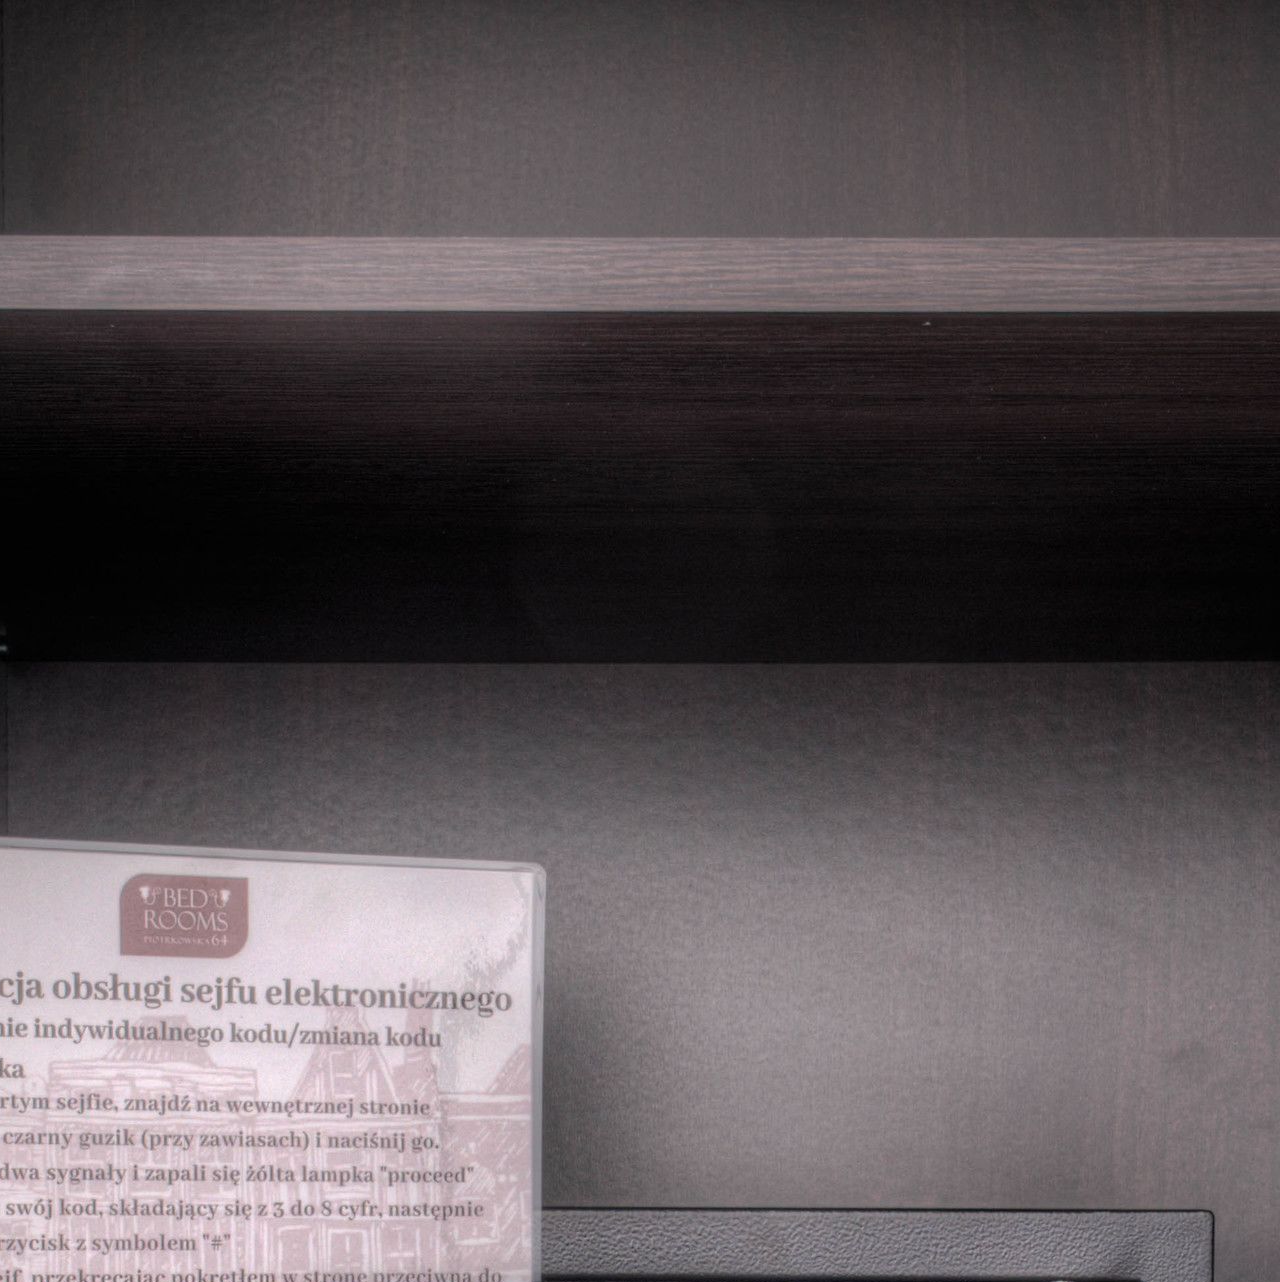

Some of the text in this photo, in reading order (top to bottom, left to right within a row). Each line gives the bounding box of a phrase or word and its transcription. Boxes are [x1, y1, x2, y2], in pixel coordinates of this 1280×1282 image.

[164, 887, 208, 908] BED
[144, 909, 228, 931] ROOMS
[211, 935, 227, 945] 64
[53, 972, 171, 1008] obsługi
[181, 978, 256, 1010] sejfu
[265, 978, 512, 1017] elektronicznego
[34, 1017, 224, 1047] indywidualnego
[230, 1023, 380, 1048] kodu/zmiana
[385, 1026, 442, 1047] kodu
[56, 1093, 119, 1114] sejfie,
[124, 1094, 191, 1116] znajdź
[197, 1100, 220, 1113] na
[227, 1099, 353, 1117] wewnętrznej
[360, 1100, 430, 1116] stronie
[3, 1128, 73, 1149] czarny
[79, 1129, 134, 1149] guzik
[141, 1130, 192, 1150] (przy
[200, 1131, 309, 1150] zawiasach)
[316, 1132, 321, 1148] i
[328, 1132, 406, 1152] naciśnij
[411, 1136, 439, 1152] go.
[46, 1165, 126, 1184] sygnały
[132, 1164, 139, 1180] i
[145, 1164, 206, 1184] zapali
[212, 1166, 240, 1185] się
[301, 1166, 374, 1186] lampka
[380, 1166, 474, 1186] "proceed"
[6, 1201, 52, 1219] swój
[60, 1199, 103, 1218] kod,
[109, 1199, 217, 1219] składający
[225, 1201, 252, 1219] się
[258, 1205, 268, 1217] z
[273, 1203, 284, 1218] 3
[291, 1201, 315, 1217] do
[321, 1201, 332, 1217] 8
[338, 1201, 382, 1218] cyfr,
[389, 1202, 484, 1219] następnie
[76, 1238, 86, 1251] z
[92, 1234, 196, 1254] symbolem
[202, 1234, 231, 1250] "#"
